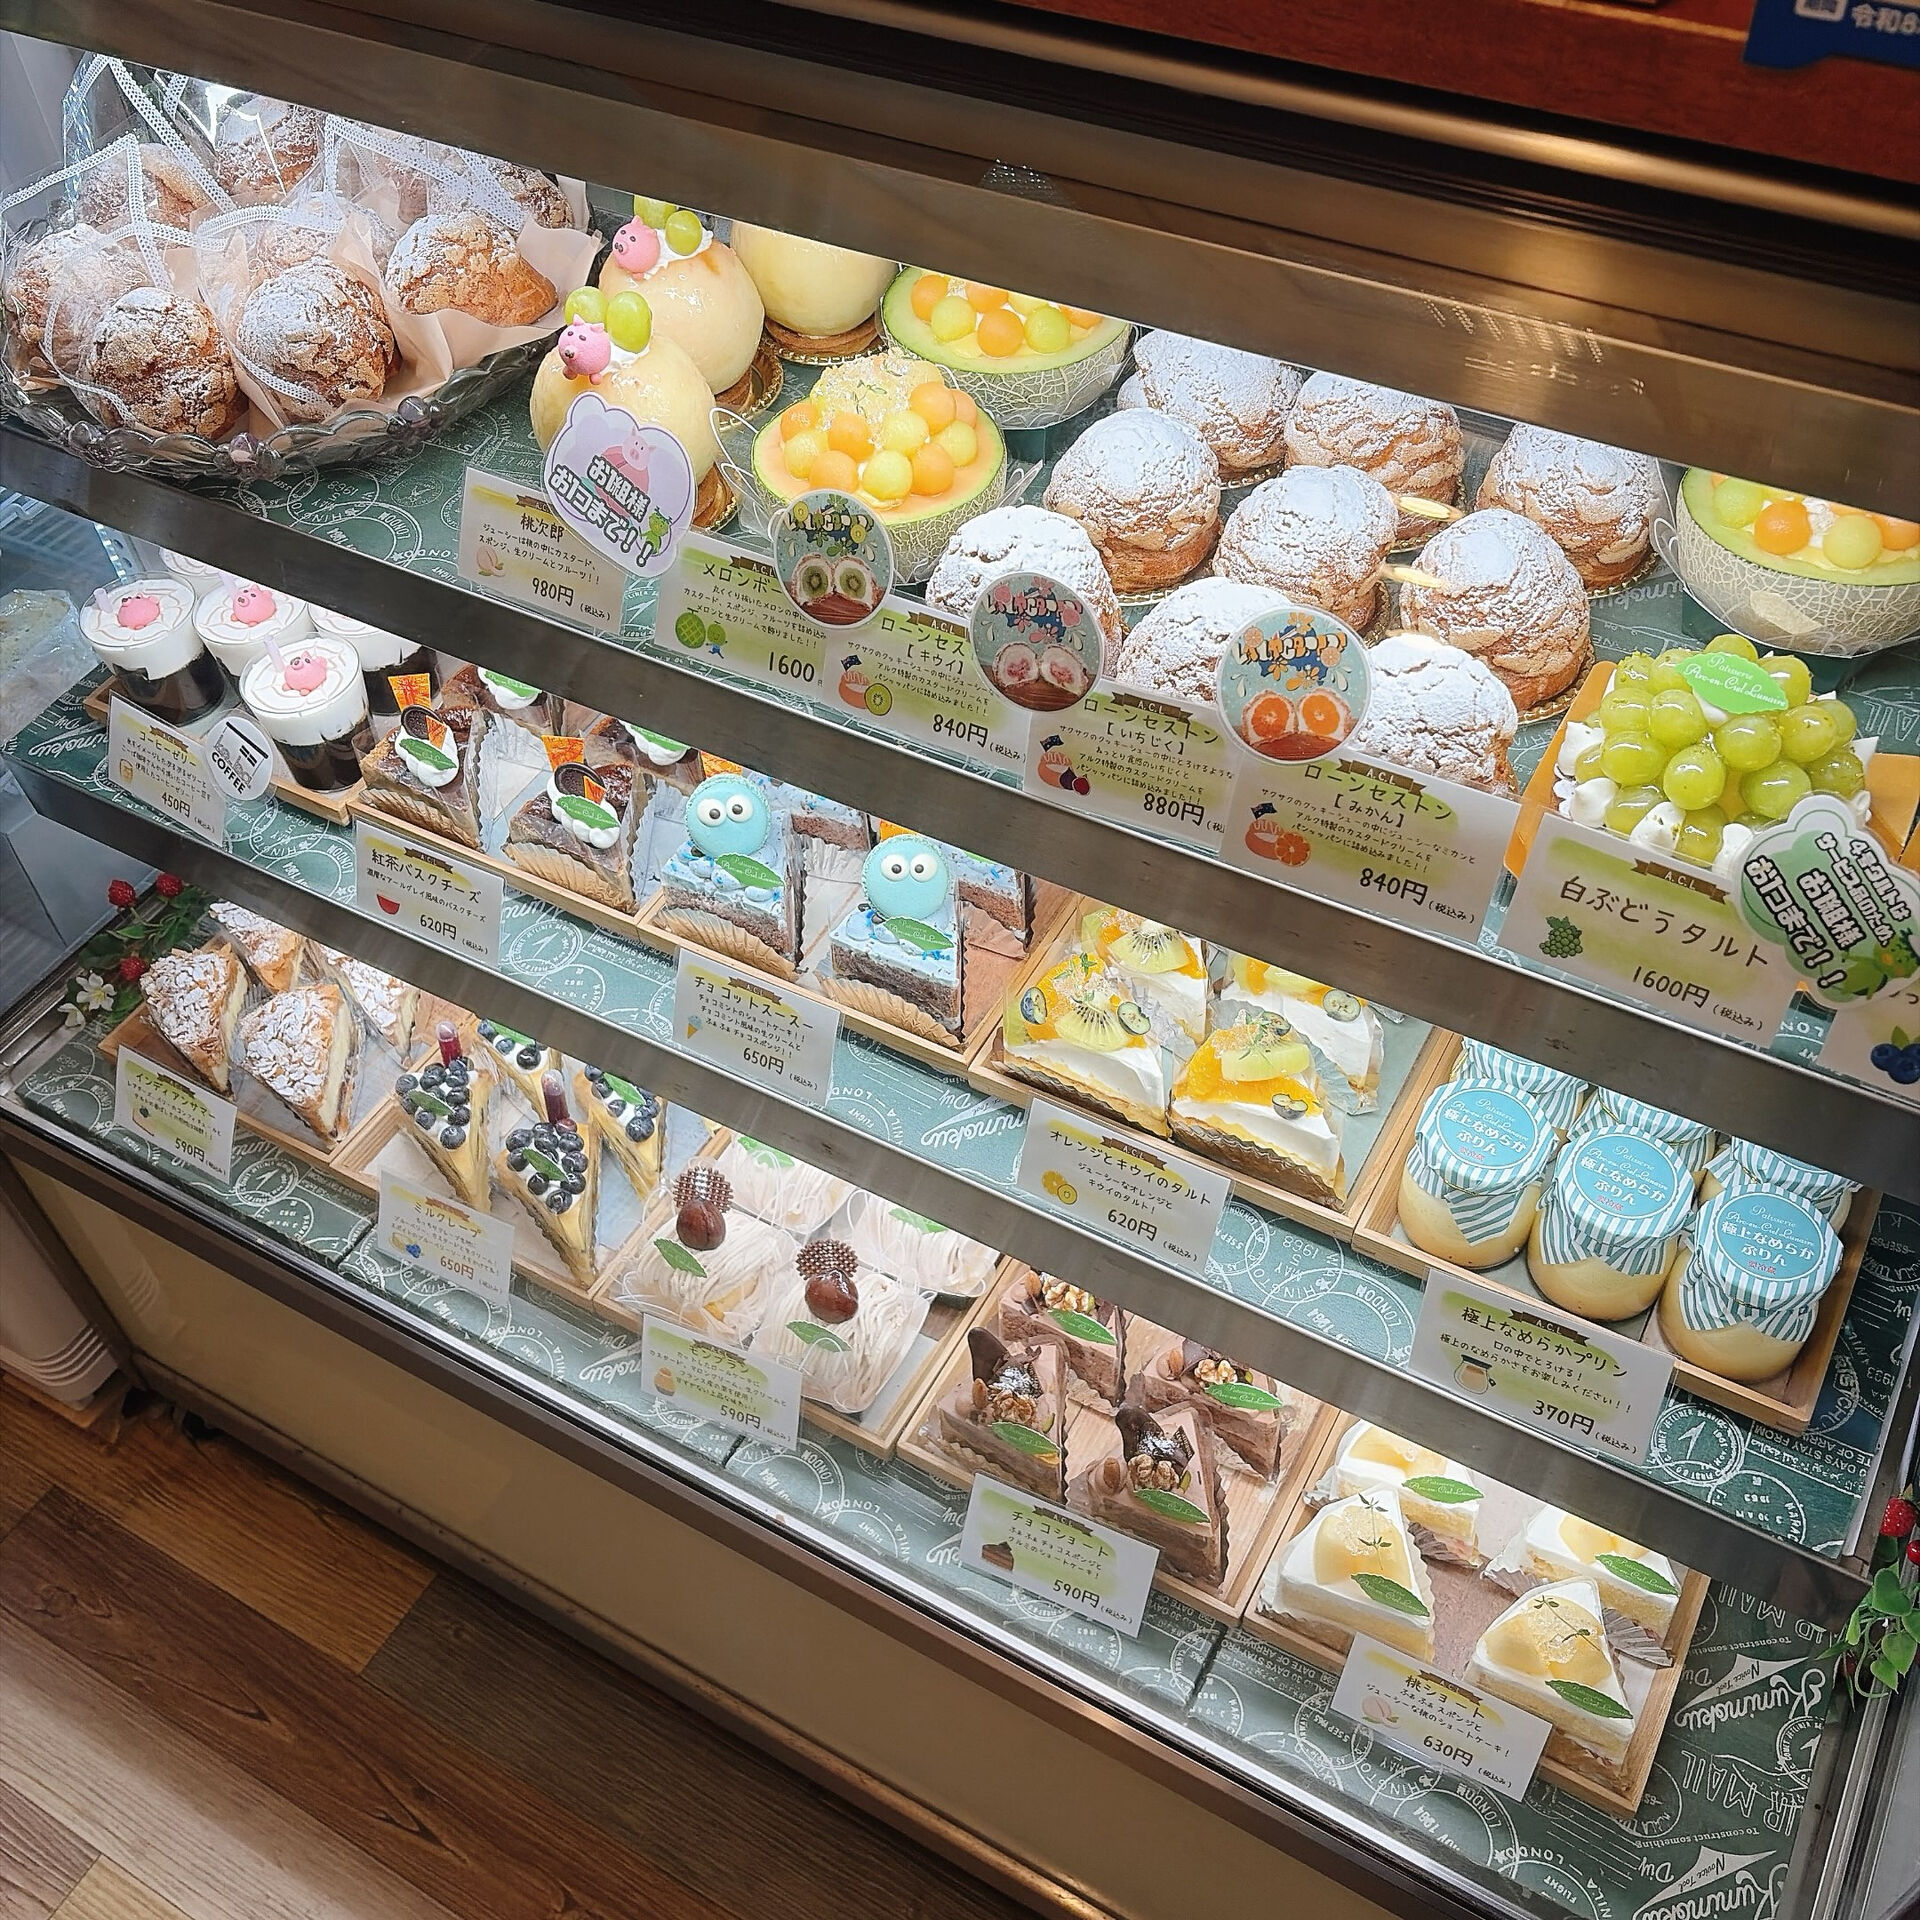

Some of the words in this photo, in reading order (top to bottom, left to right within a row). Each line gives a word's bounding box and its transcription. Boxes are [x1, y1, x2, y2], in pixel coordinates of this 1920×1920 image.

[520, 513, 565, 542] 桃次郎
[532, 577, 574, 606] 980円
[907, 644, 964, 675] 【キウイ】
[1084, 699, 1219, 744] ローンセストン
[1138, 701, 1165, 714] A.C.L
[933, 714, 988, 747] 840円
[1107, 722, 1185, 755] 【いちじく】
[140, 731, 197, 766] コーヒーゼリー
[211, 751, 246, 794] COFFEE
[1366, 771, 1396, 786] A.C.L
[162, 792, 190, 818] 450円
[1305, 765, 1452, 820] ローンセストン
[1143, 793, 1205, 826] 880円
[1333, 794, 1404, 828] 【みかん】
[372, 849, 481, 903] 紅茶バスクチーズ
[1360, 868, 1428, 905] 840円
[1664, 870, 1697, 890] A.C.L
[420, 915, 456, 940] 620円
[1560, 876, 1767, 967] 白ぶどうタルト
[695, 977, 813, 1029] チョコットスースー
[1633, 966, 1710, 1008] 1600円
[744, 1048, 783, 1074] 650円
[137, 1073, 215, 1118] インディアンサマー
[1444, 1108, 1527, 1154] 極上なめらか
[1456, 1131, 1498, 1155] ぷりん
[175, 1137, 204, 1162] 590円
[1051, 1130, 1210, 1206] オレンジとキウイのタルト
[1580, 1156, 1666, 1203] 極上なめらか
[1078, 1162, 1172, 1210] ジューシーなオレンジと
[1594, 1180, 1637, 1206] ぷりん
[415, 1202, 482, 1237] ミルクレープ
[1108, 1210, 1157, 1241] 620円
[1721, 1220, 1815, 1260] 極上なめらか
[1742, 1244, 1787, 1266] ぷりん
[441, 1256, 474, 1280] 650円
[1461, 1306, 1628, 1377] 極上なめらかプリン
[690, 1347, 749, 1373] モンブラン
[1493, 1341, 1582, 1381] 口の中でとろける！
[720, 1405, 760, 1429] 590円
[1533, 1400, 1595, 1435] 370円
[1012, 1511, 1108, 1557] チョコショート
[1053, 1580, 1099, 1608] 590円
[1406, 1675, 1485, 1719] 桃ショート
[1423, 1736, 1473, 1767] 630円
